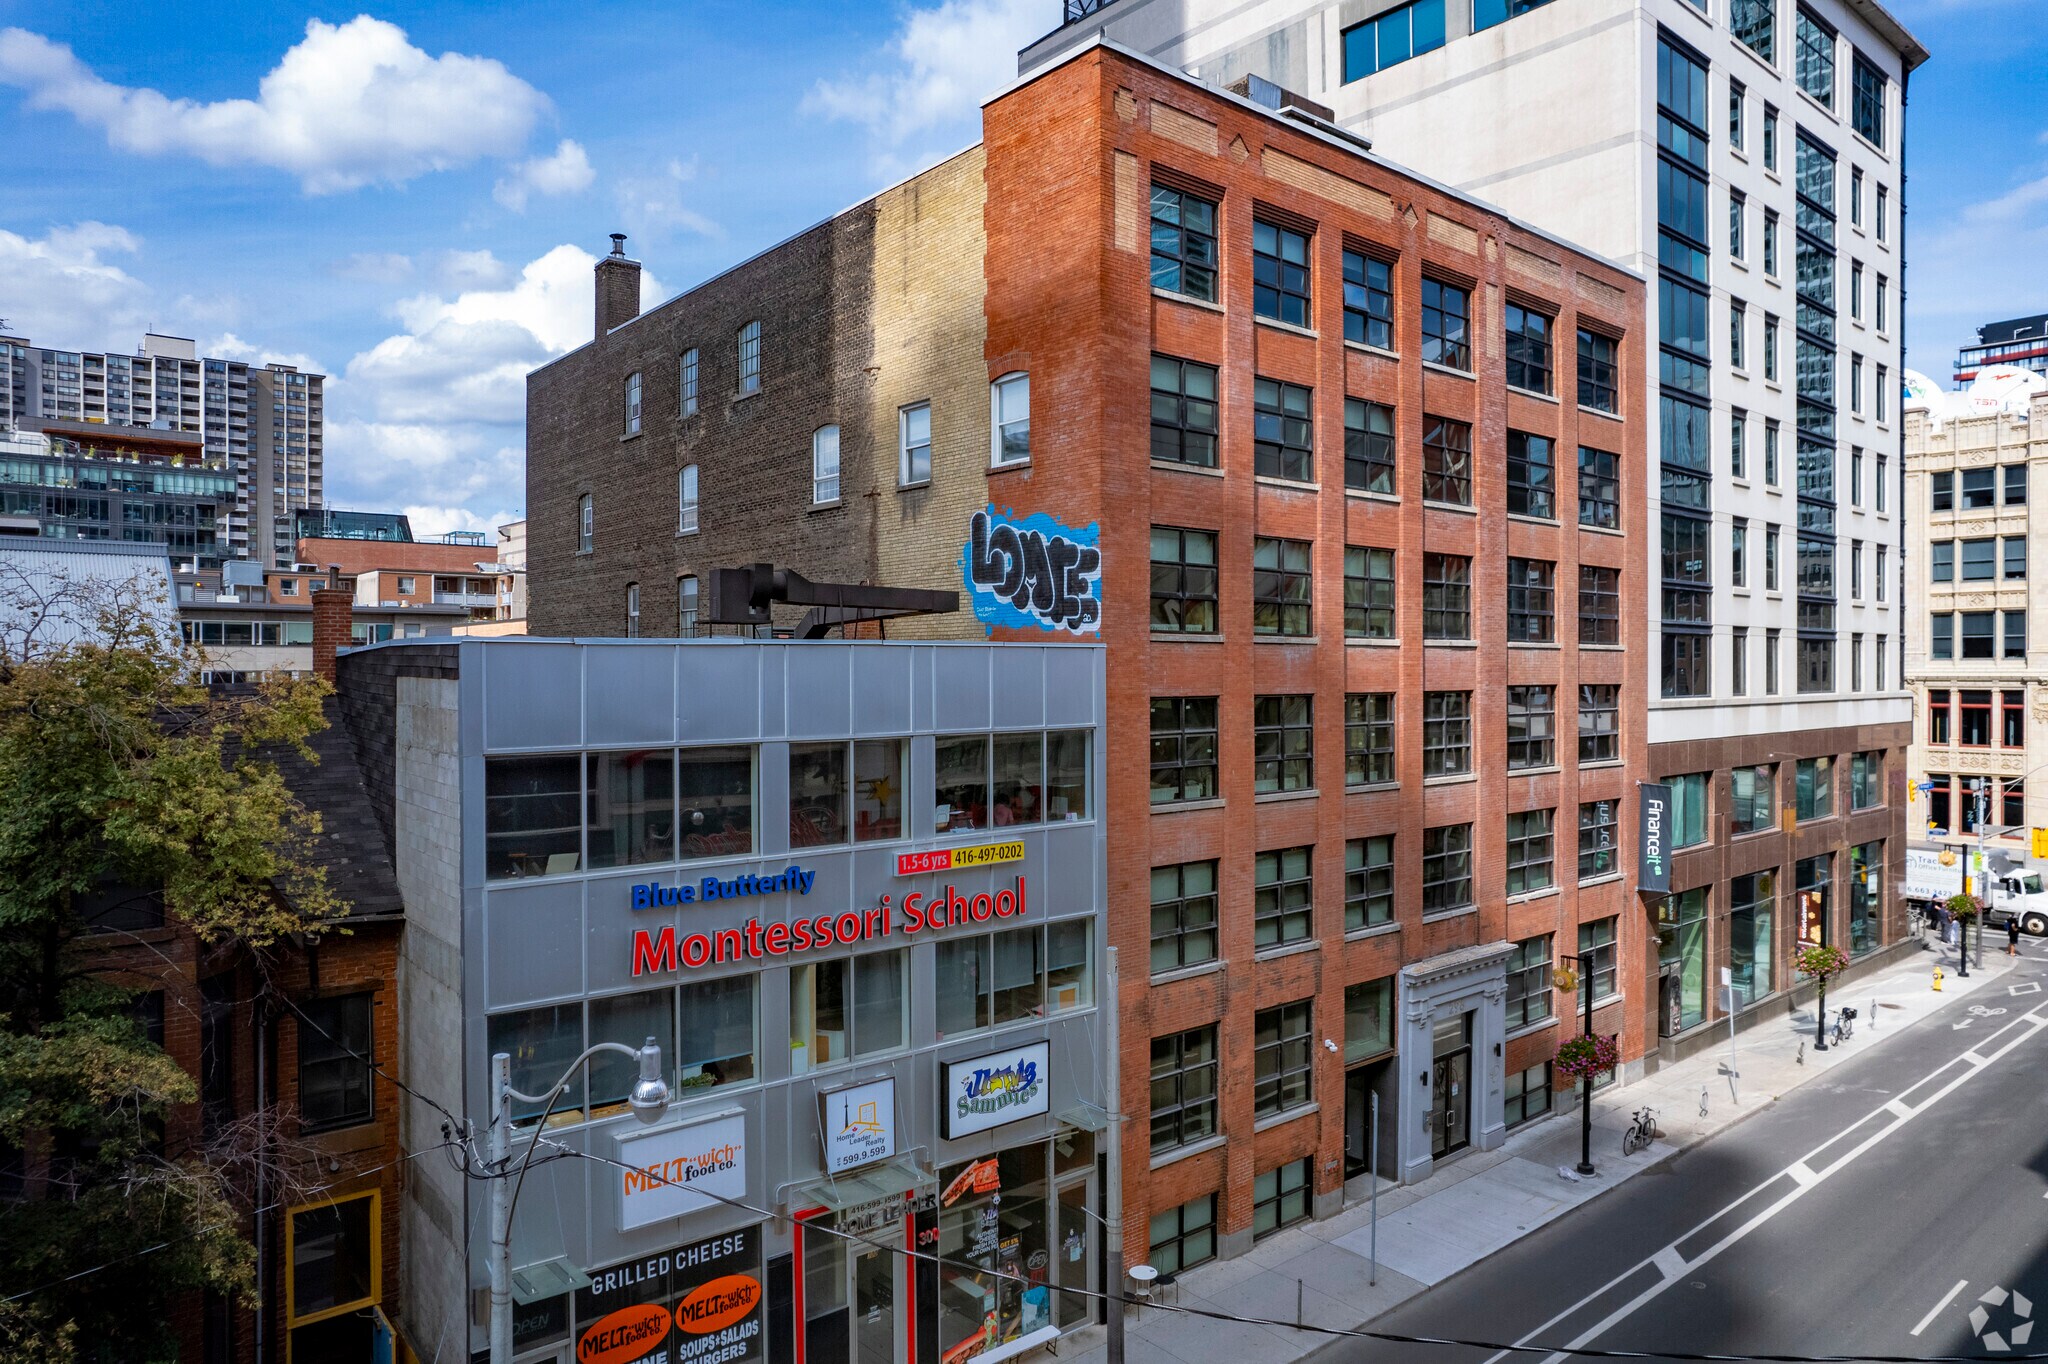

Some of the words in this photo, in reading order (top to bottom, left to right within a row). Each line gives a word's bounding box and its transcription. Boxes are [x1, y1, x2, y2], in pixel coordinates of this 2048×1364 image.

[1647, 799, 1663, 865] Financeit
[901, 855, 929, 871] 1.5-6
[931, 854, 948, 869] yrs
[955, 844, 1022, 865] 416-497-0202
[631, 882, 696, 910] Blue
[701, 865, 816, 902] Butterfly
[632, 894, 892, 977] Montessori
[902, 875, 1027, 935] School
[836, 1133, 855, 1142] Home
[849, 1134, 871, 1145] Leader
[866, 1137, 885, 1147] Realty
[843, 1145, 886, 1166] 599.9.599
[685, 1162, 715, 1182] food
[719, 1160, 737, 1171] co.
[918, 1227, 940, 1246] 300
[592, 1257, 670, 1295] GRILLED
[675, 1234, 744, 1270] CHEESE
[719, 1299, 740, 1314] food
[625, 1330, 648, 1345] food
